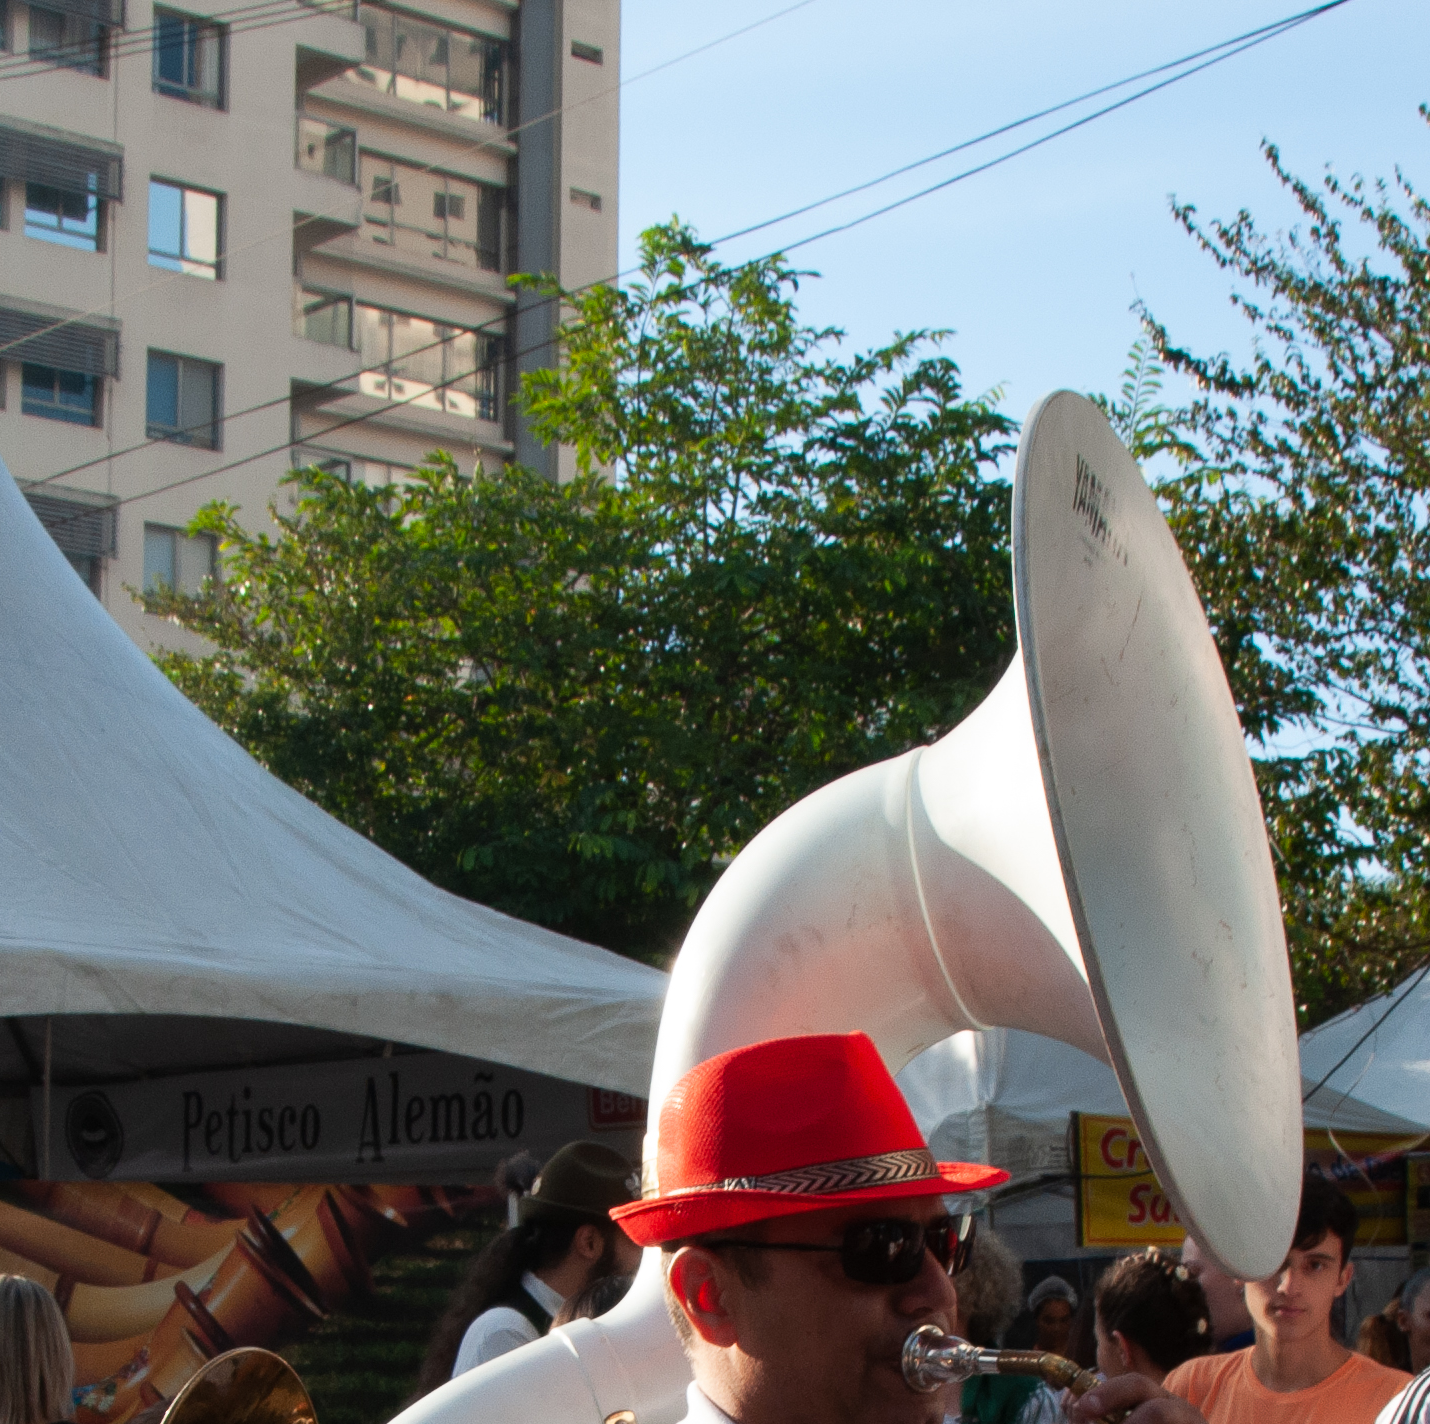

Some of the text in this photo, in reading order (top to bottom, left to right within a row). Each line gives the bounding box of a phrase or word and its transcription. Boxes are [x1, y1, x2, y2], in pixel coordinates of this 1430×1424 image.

[182, 1071, 525, 1172] Petisco Alemão
[1101, 1128, 1151, 1168] Cr
[1128, 1183, 1180, 1223] Su
